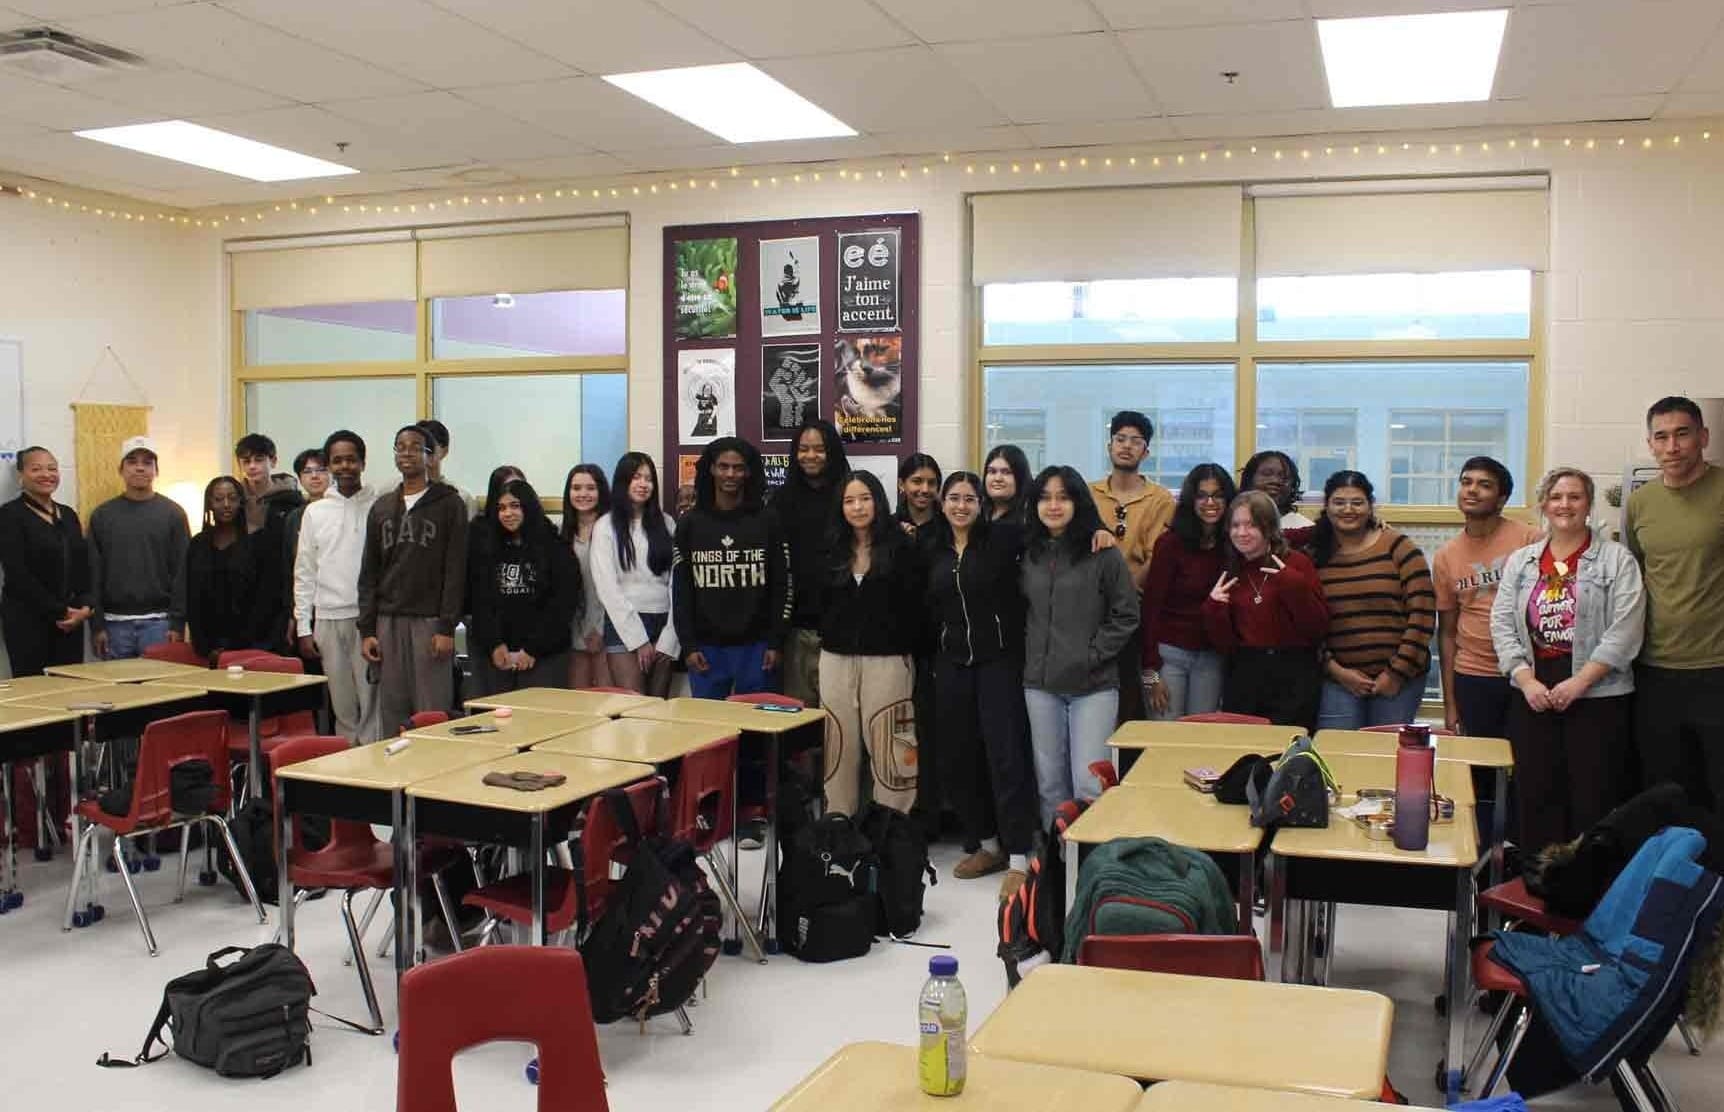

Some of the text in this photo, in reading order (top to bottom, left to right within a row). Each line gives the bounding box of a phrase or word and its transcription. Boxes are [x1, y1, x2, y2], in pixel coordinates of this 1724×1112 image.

[844, 275, 891, 292] J'aime
[855, 293, 880, 306] ton
[842, 306, 894, 321] accent.
[381, 514, 437, 549] GAP
[691, 550, 722, 563] KINGS
[726, 550, 740, 563] OF
[743, 549, 766, 562] THE
[692, 563, 766, 588] NORTH
[1539, 614, 1563, 632] POR
